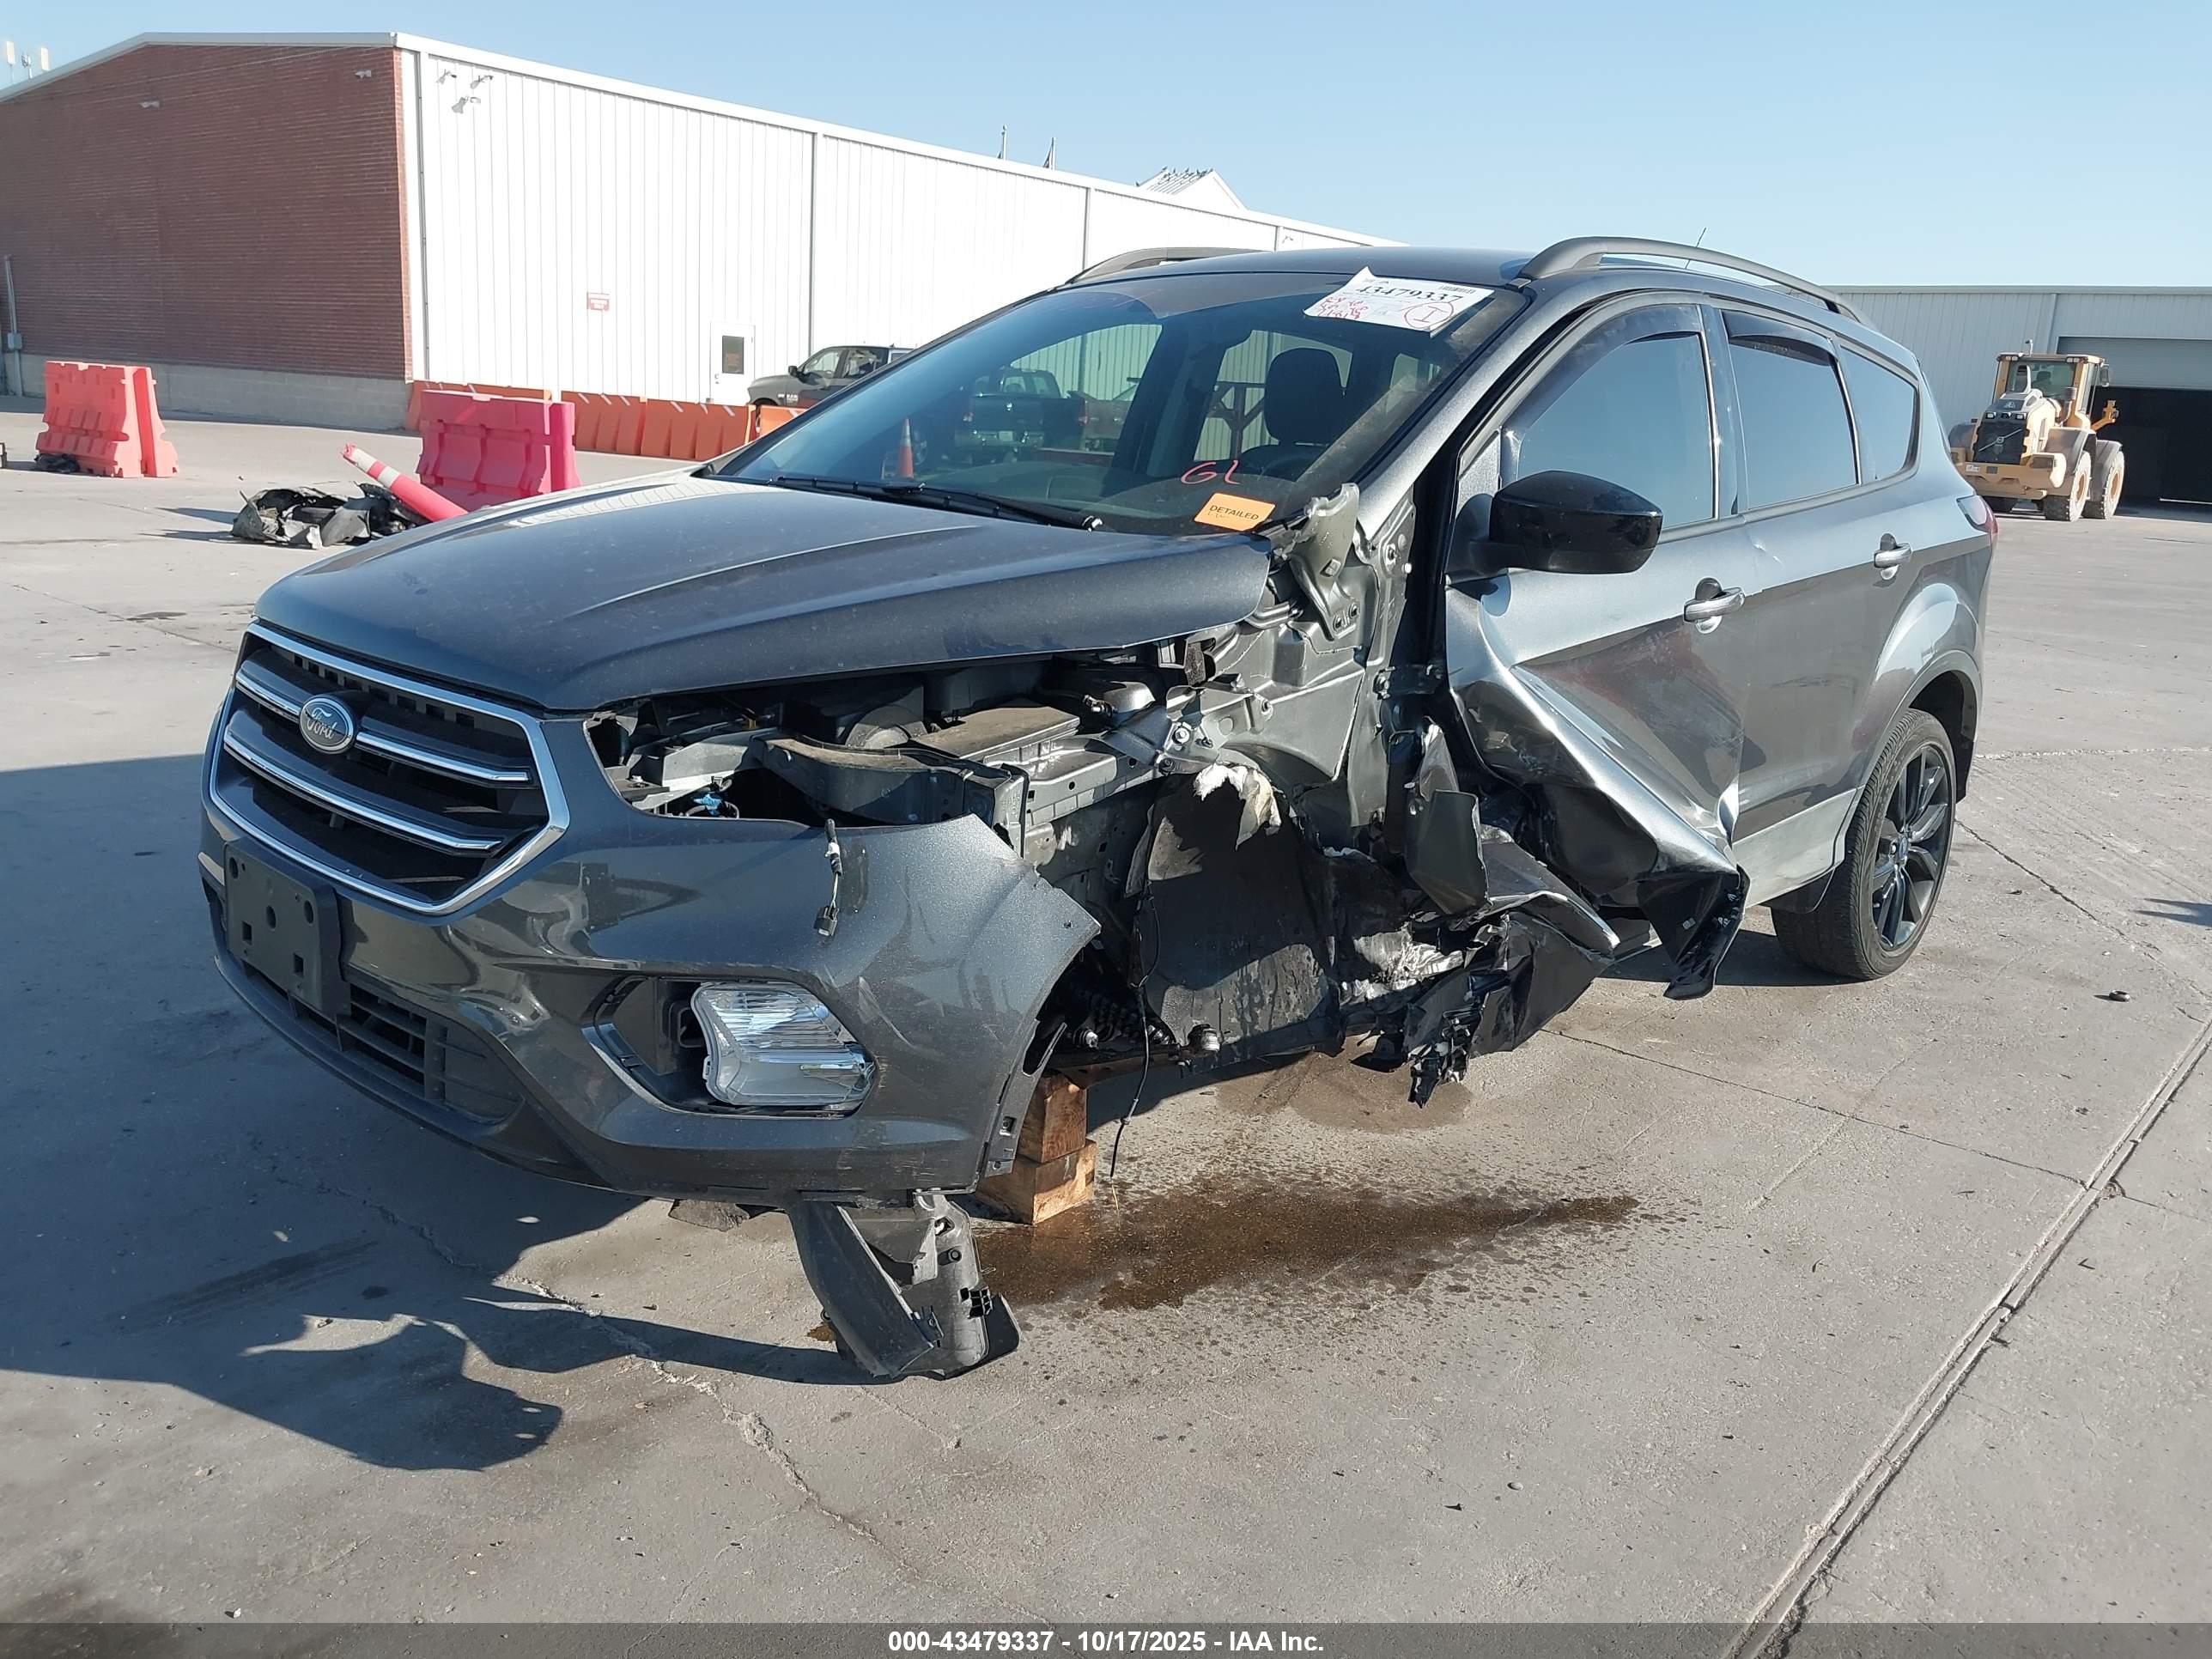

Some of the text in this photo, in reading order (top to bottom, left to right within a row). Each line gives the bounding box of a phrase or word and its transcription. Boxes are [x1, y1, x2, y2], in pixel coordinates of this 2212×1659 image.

[1355, 284, 1464, 303] 43479337
[1209, 505, 1260, 520] DETAILED
[307, 707, 337, 739] Ford
